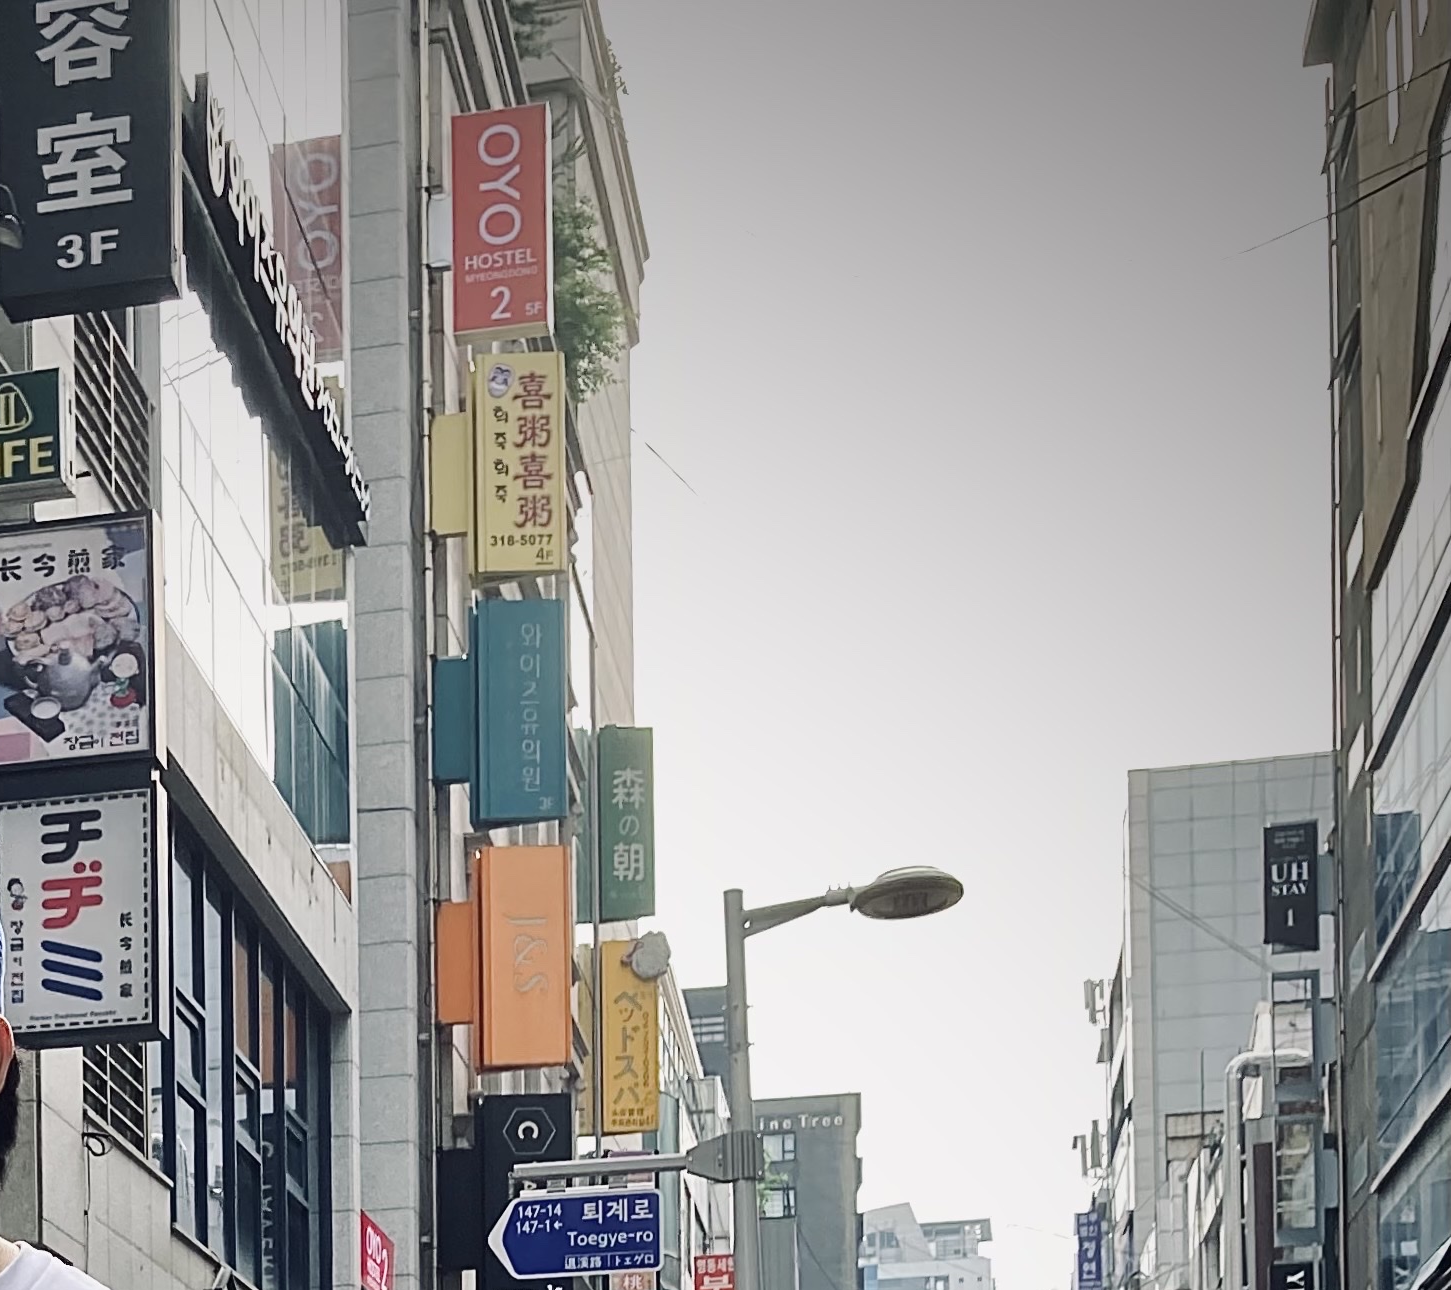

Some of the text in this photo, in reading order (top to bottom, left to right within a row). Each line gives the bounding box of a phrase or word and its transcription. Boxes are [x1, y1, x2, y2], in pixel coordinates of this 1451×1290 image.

[477, 123, 521, 246] OYO
[56, 228, 119, 270] 3F
[465, 248, 537, 271] HOSTEL
[490, 286, 511, 321] 2
[493, 405, 509, 504] 희죽희죽
[513, 370, 553, 529] 喜粥喜粥
[490, 533, 553, 547] 318-5077
[520, 622, 542, 793] 와이즈유의원
[63, 729, 140, 751] 장금이 전집
[612, 767, 646, 882] 森の朝
[1270, 861, 1309, 884] UH
[1271, 883, 1309, 897] STAY
[40, 808, 104, 1002] チヂミ
[1286, 908, 1295, 927] 1
[799, 1113, 844, 1128] Tree
[517, 1203, 562, 1219] 147-14
[581, 1198, 654, 1224] 퇴계로
[516, 1219, 553, 1235] 147-1
[566, 1229, 654, 1248] Toegye-ro
